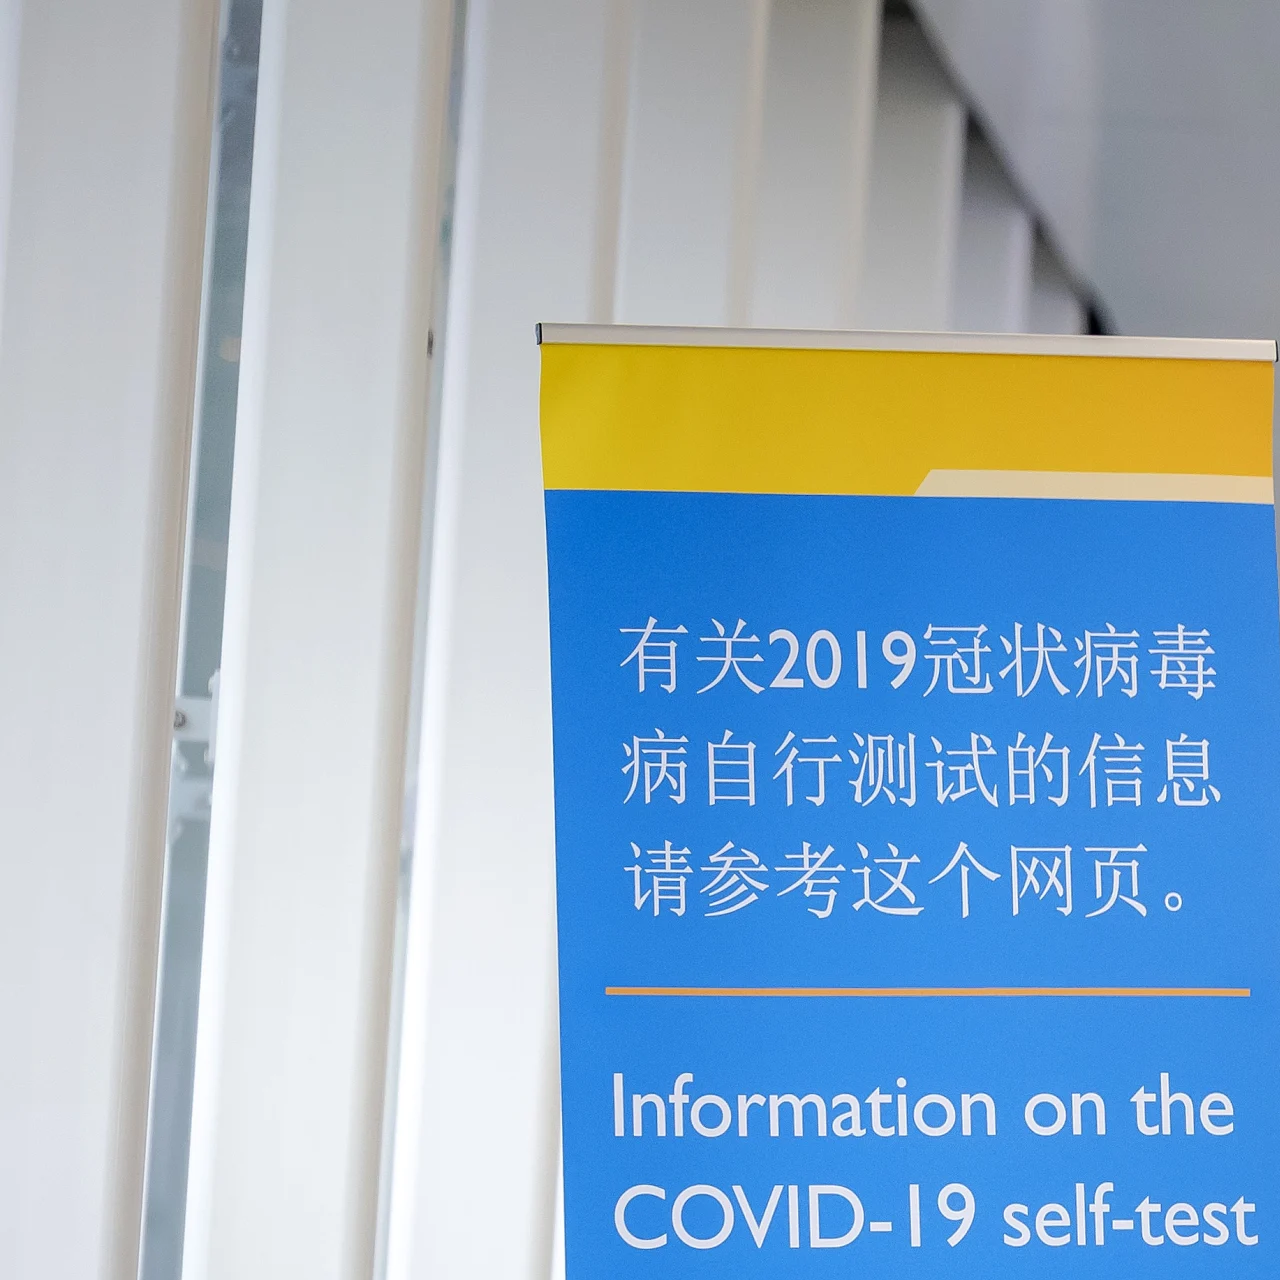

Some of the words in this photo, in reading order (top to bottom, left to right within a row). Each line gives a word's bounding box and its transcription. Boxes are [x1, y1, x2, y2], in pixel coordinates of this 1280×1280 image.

[619, 616, 1217, 701] 有关2019冠状病毒
[621, 727, 1221, 809] 病自行测试的信息
[623, 839, 1185, 919] 请参考这个网页。
[613, 1072, 997, 1138] Information
[1024, 1092, 1106, 1136] on
[1129, 1072, 1234, 1136] the
[614, 1182, 976, 1250] COVID-19
[1003, 1181, 1259, 1247] self-test
